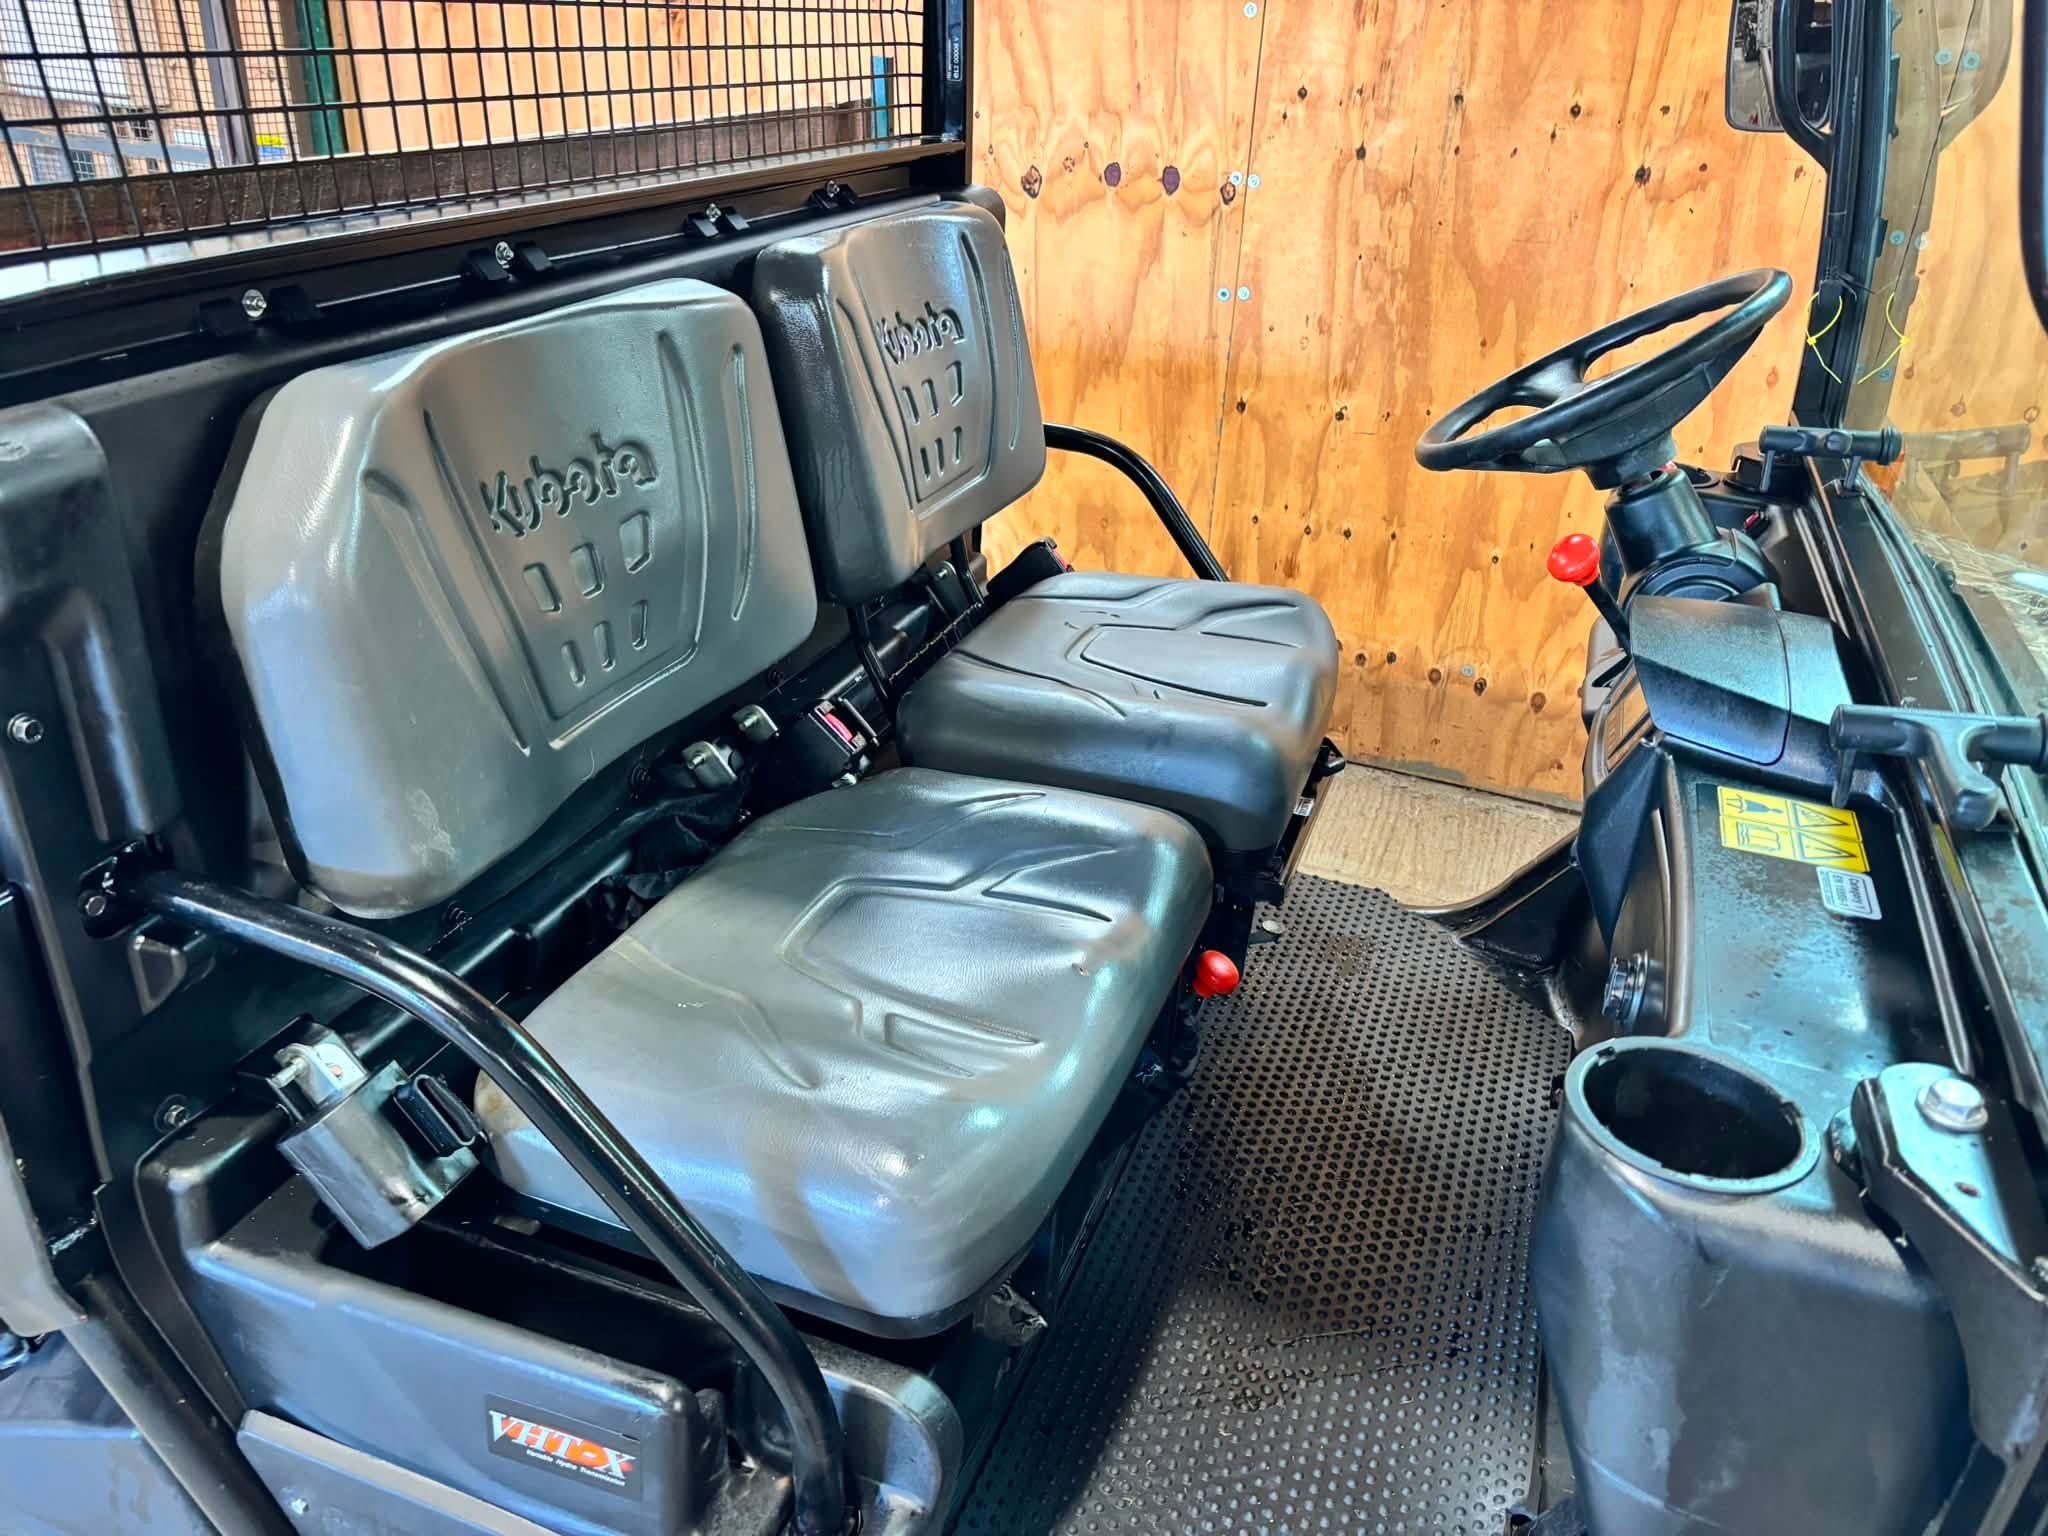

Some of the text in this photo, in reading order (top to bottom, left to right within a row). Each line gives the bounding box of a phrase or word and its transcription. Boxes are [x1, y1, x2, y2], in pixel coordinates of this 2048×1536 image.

[876, 301, 966, 367] Kubota
[479, 431, 658, 538] Kubota
[526, 1449, 626, 1487] Variable Hydro Transmission
